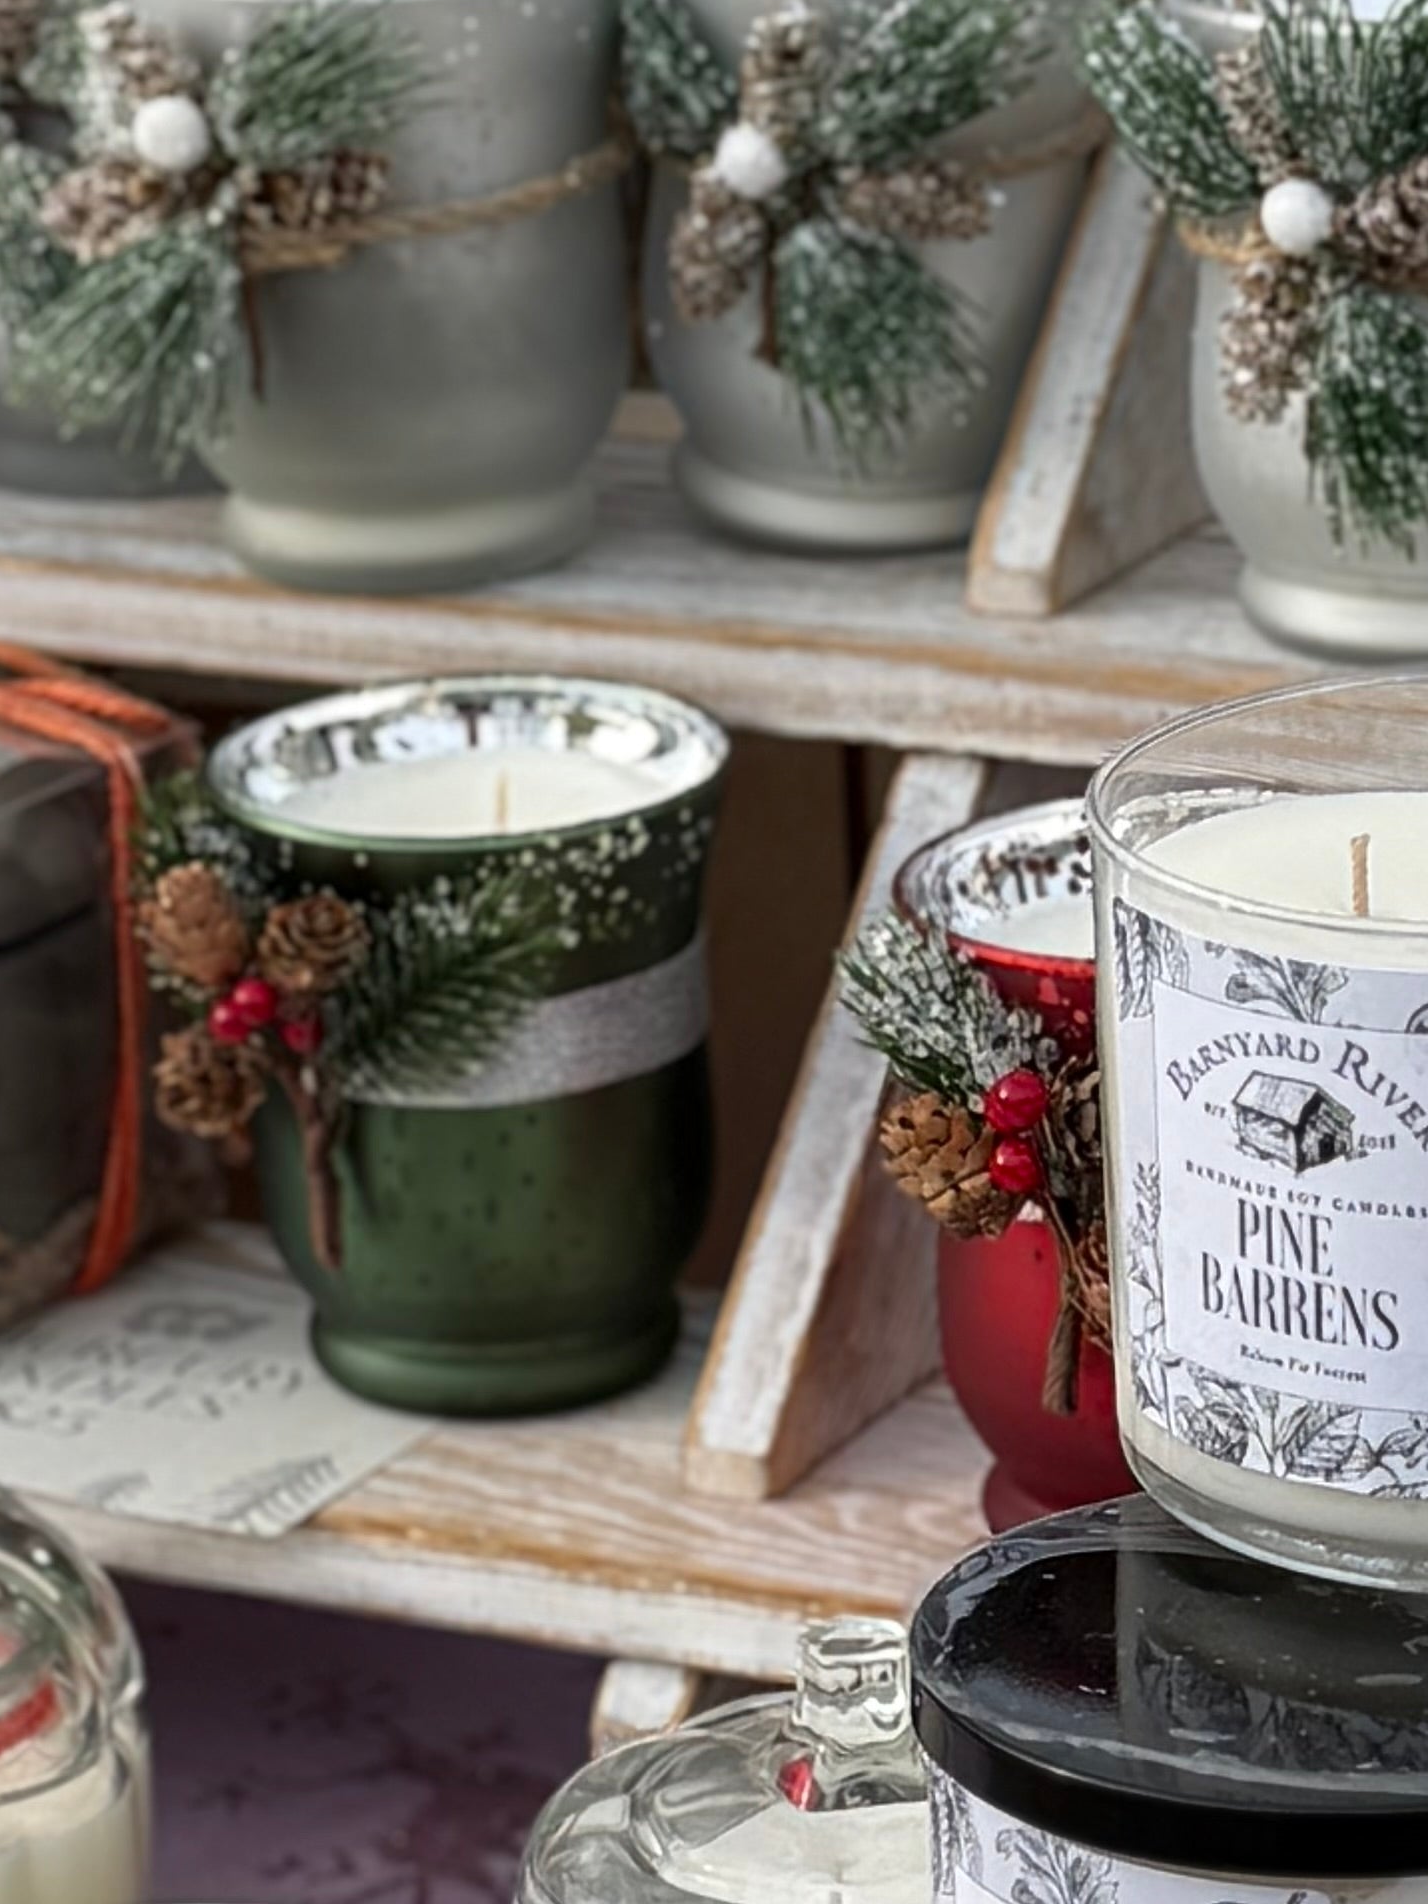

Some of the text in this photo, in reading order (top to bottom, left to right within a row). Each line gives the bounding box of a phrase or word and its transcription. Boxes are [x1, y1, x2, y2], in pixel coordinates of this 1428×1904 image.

[1166, 1032, 1320, 1101] BARNYARD
[1238, 1198, 1333, 1277] PINE
[1202, 1251, 1399, 1352] BARRENS
